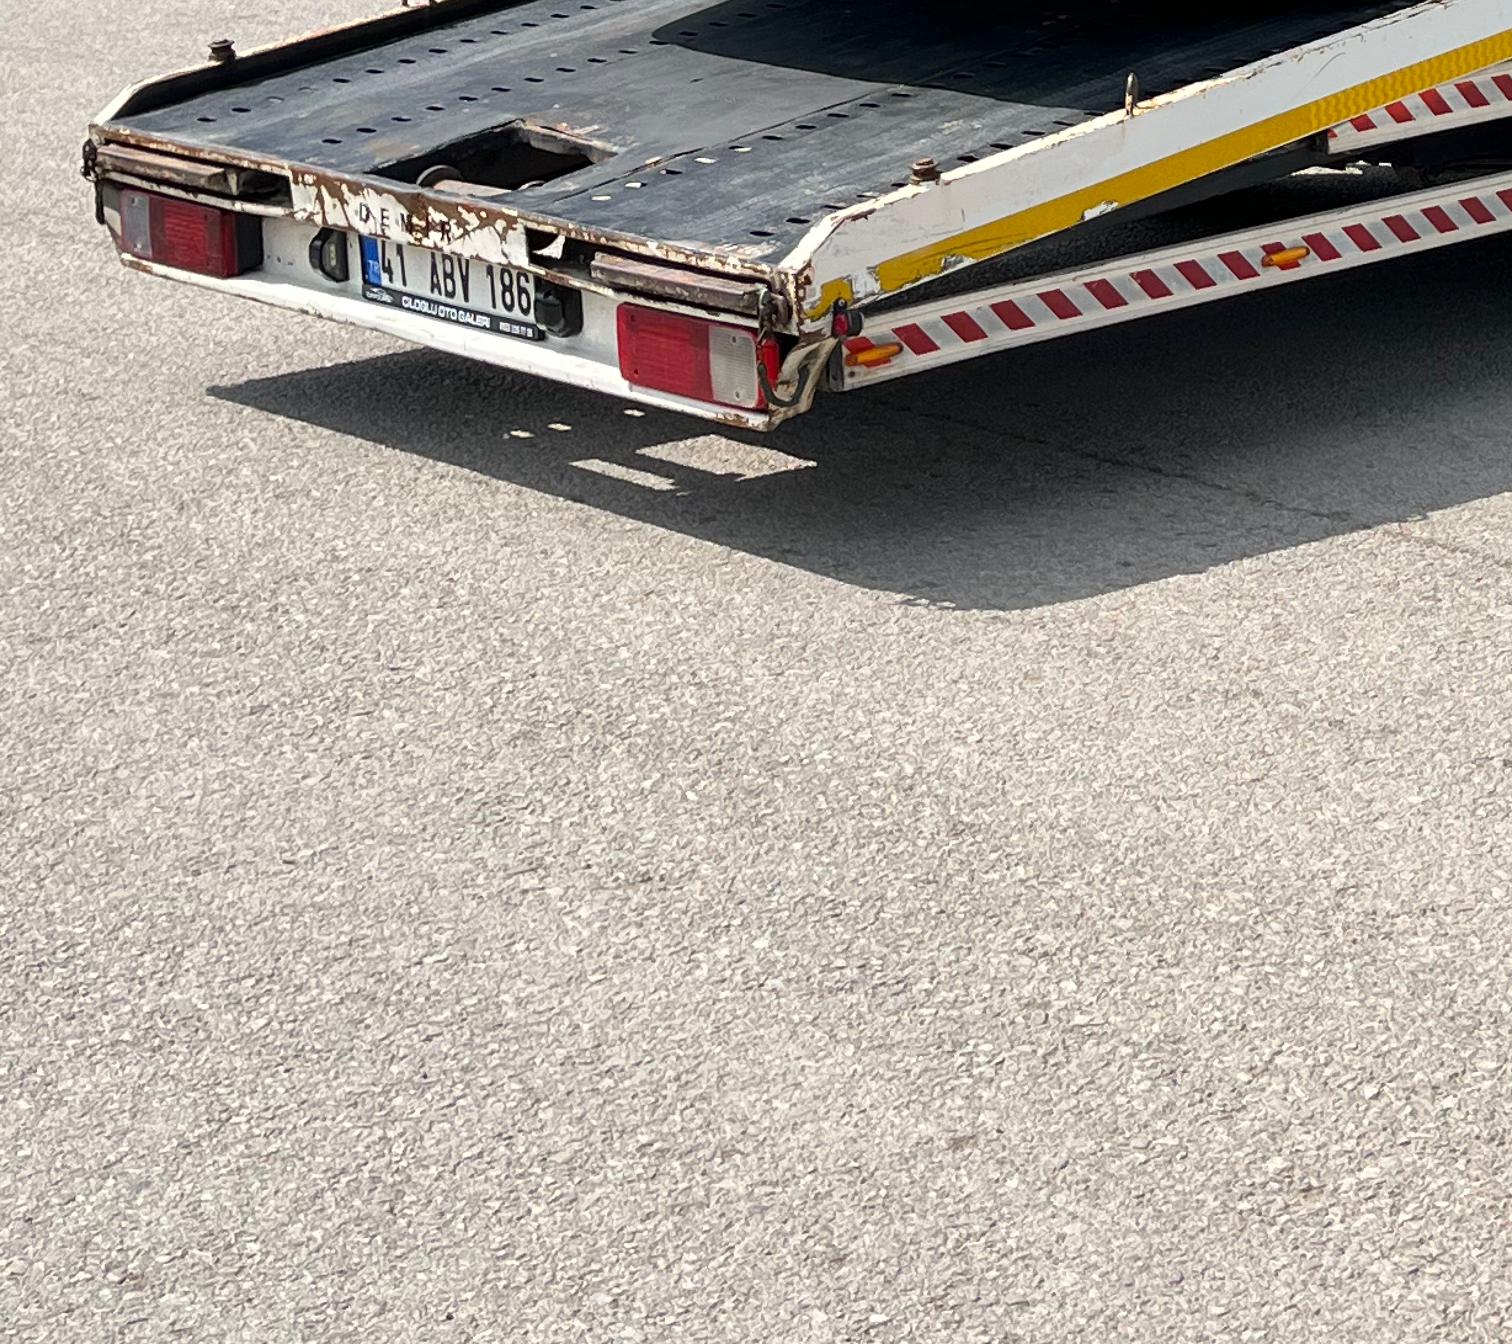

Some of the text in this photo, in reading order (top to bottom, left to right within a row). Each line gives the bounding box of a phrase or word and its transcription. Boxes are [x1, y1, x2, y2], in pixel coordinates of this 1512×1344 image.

[381, 239, 532, 317] 41 ABV 186
